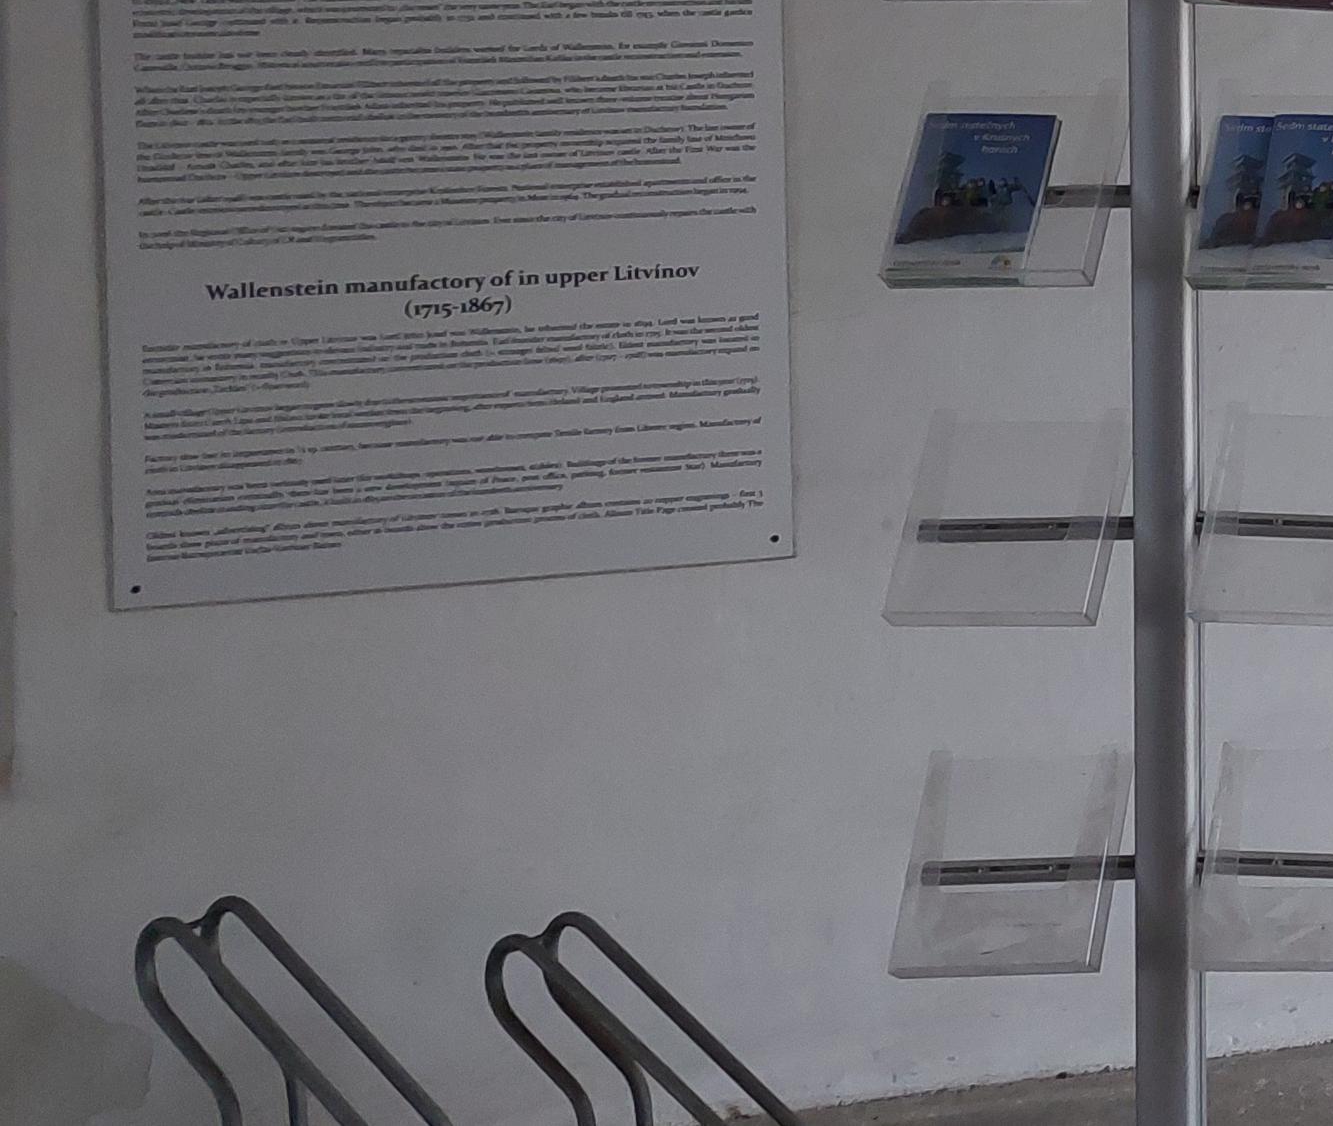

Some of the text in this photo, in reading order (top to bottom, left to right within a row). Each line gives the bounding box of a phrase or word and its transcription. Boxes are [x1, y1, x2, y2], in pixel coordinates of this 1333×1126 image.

[205, 262, 701, 303] Wallenstein manufactory of in upper Litvínov
[403, 294, 513, 319] (1715-1867)
